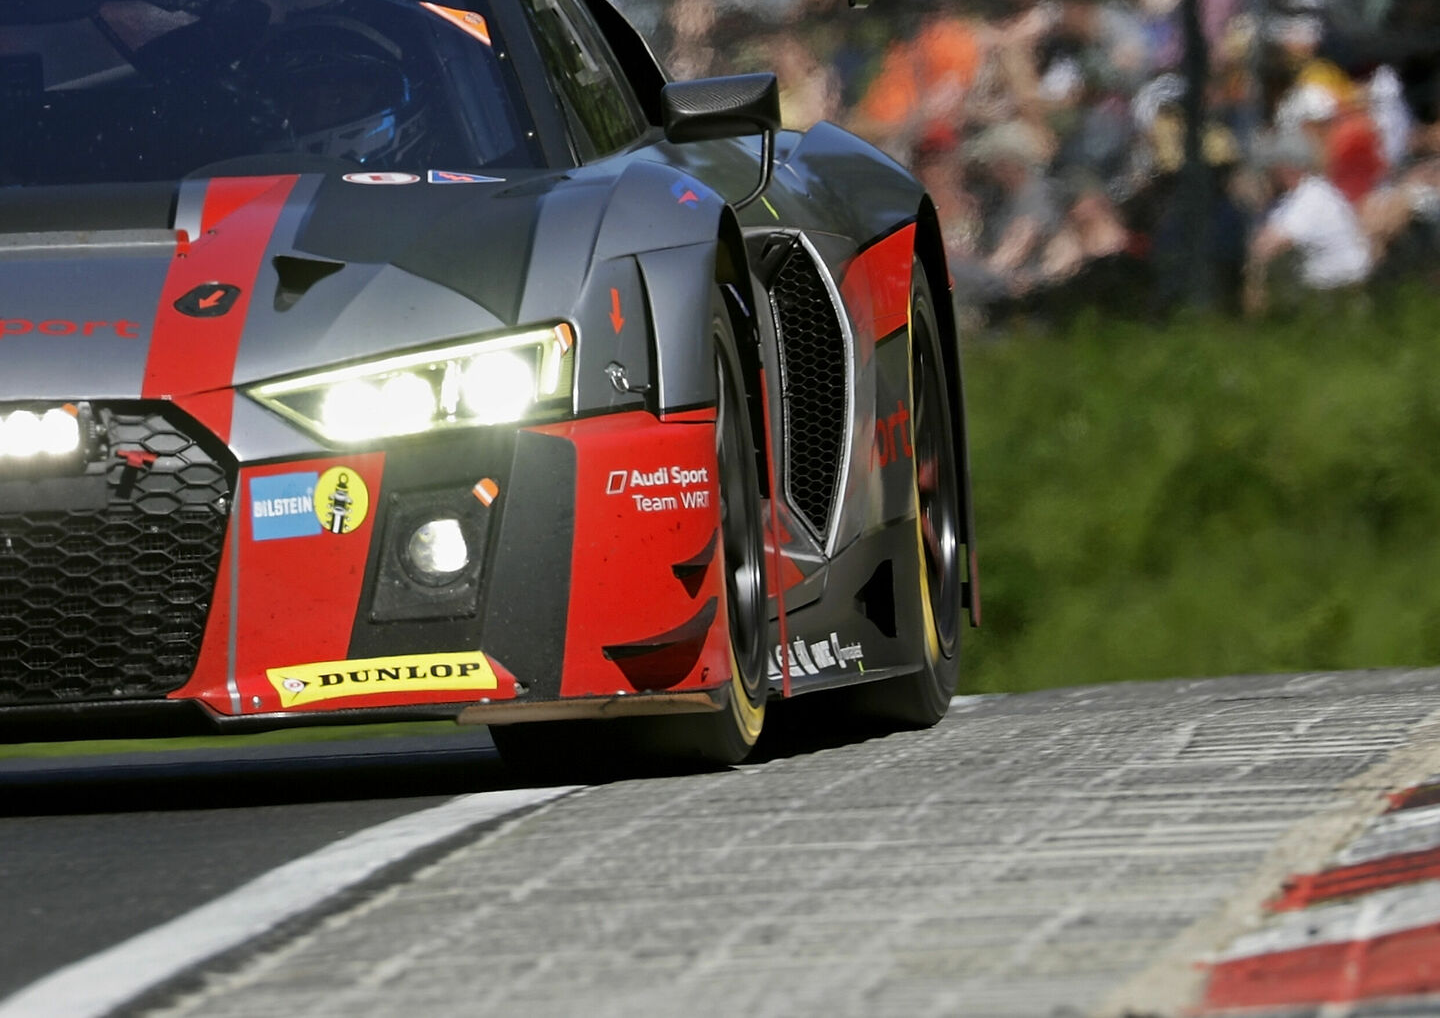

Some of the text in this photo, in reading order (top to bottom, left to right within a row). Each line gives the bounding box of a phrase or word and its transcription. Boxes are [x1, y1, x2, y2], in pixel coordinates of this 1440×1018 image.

[630, 466, 709, 488] Audi Sport
[632, 491, 710, 512] Team WRT
[318, 662, 481, 687] DUNLOP
